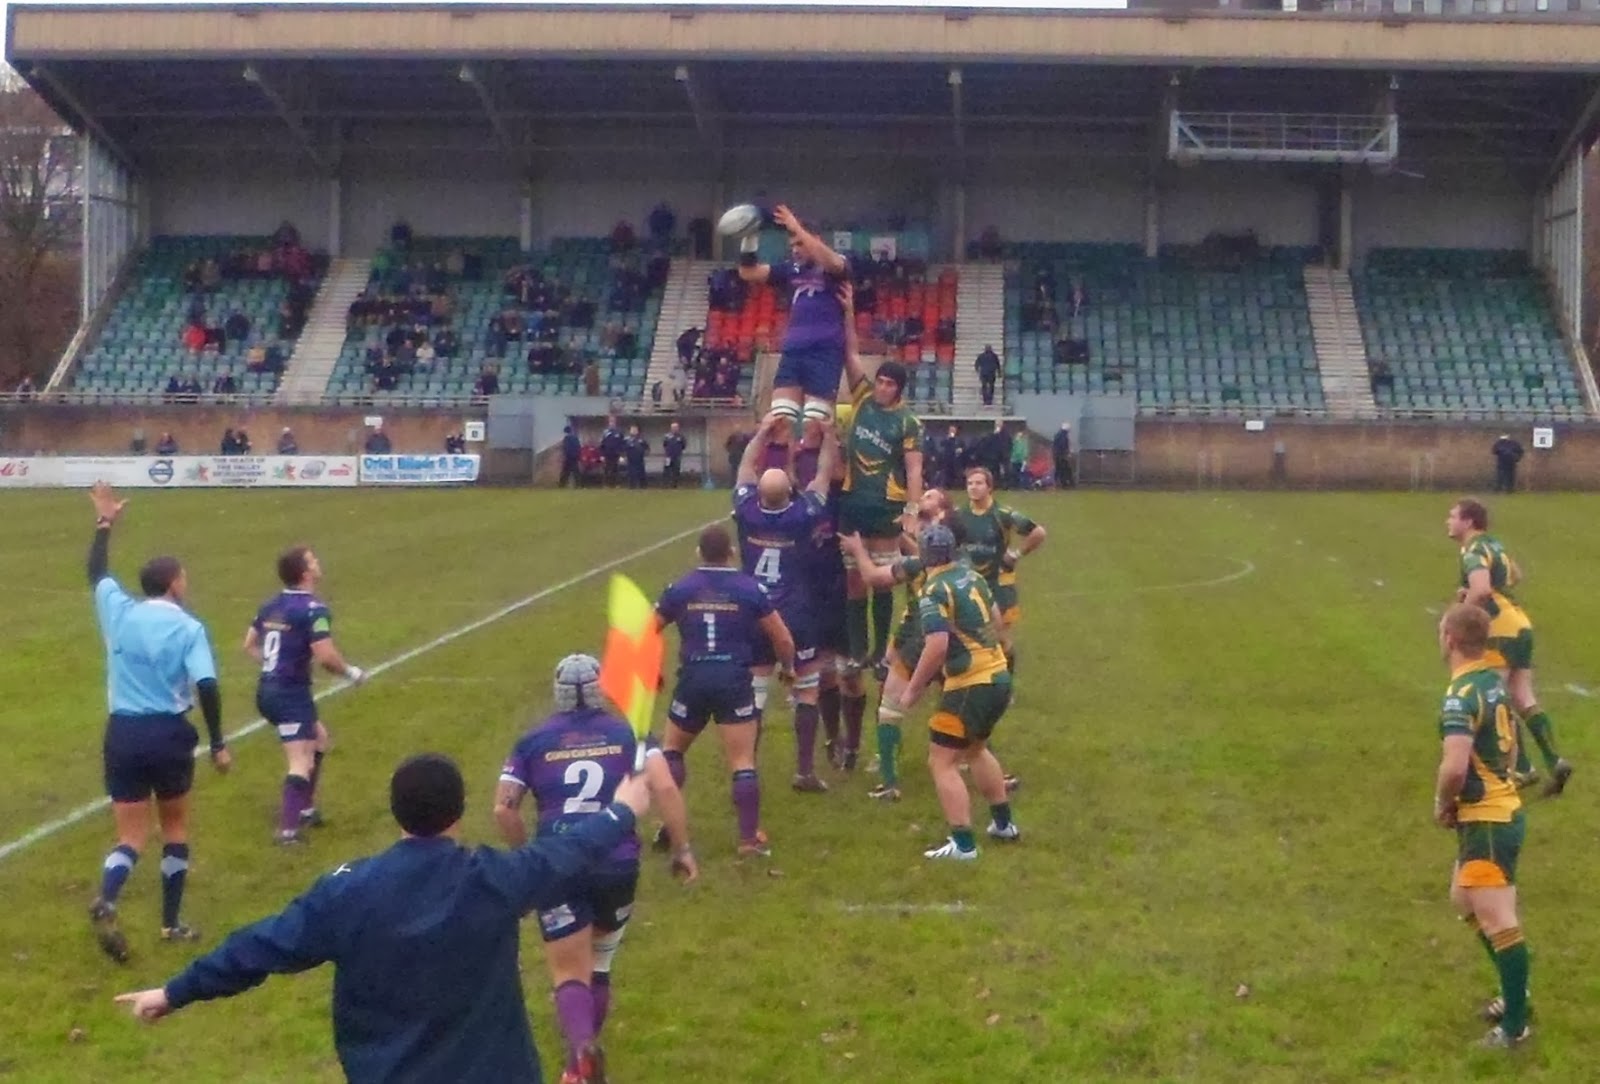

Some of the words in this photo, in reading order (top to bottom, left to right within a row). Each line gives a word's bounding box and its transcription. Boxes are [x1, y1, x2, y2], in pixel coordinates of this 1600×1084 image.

[754, 548, 781, 583] 4
[262, 630, 281, 673] 9
[703, 612, 715, 653] 1
[1495, 704, 1513, 754] 9
[563, 760, 604, 814] 2
